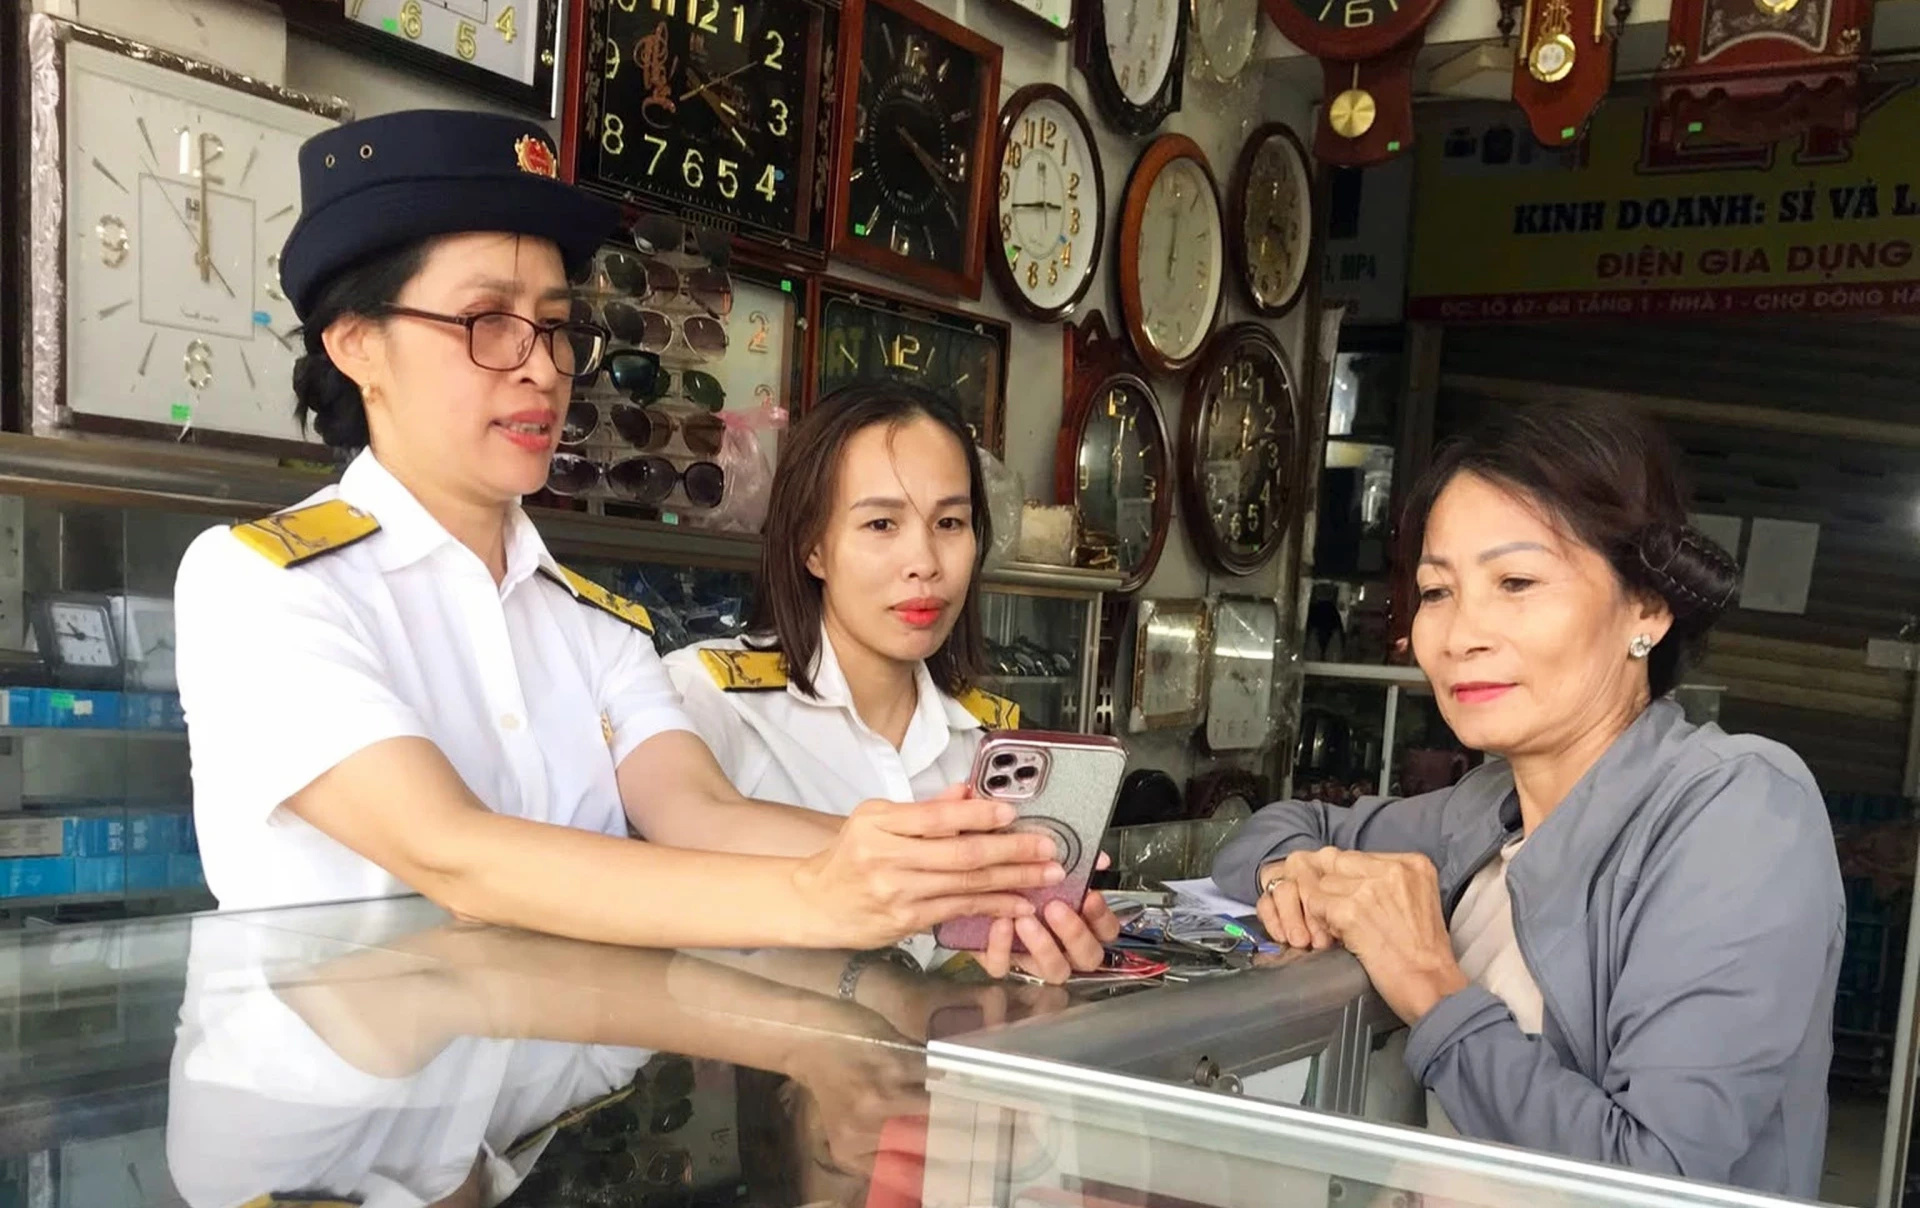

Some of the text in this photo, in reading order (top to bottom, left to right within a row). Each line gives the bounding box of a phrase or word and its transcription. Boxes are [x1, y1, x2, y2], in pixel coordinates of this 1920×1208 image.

[401, 1, 422, 40] 6
[494, 6, 517, 44] 4
[687, 0, 719, 34] 12
[733, 4, 744, 43] 1
[1344, 0, 1374, 28] 6
[457, 19, 477, 61] 5
[764, 30, 785, 71] 2
[602, 113, 624, 154] 8
[769, 99, 788, 137] 3
[1023, 117, 1035, 149] 11
[1040, 116, 1057, 148] 12
[644, 134, 667, 176] 7
[682, 149, 704, 188] 6
[1062, 138, 1068, 167] 1
[718, 159, 739, 198] 5
[755, 164, 776, 202] 4
[1068, 173, 1080, 199] 2
[1514, 201, 1606, 234] KINH
[1617, 195, 1766, 231] DOANH:
[1892, 184, 1920, 215] L
[96, 215, 130, 268] 9
[1597, 241, 1912, 284] ĐIỆN GIA DỤNG
[748, 311, 770, 354] 2
[183, 337, 213, 390] 6
[891, 334, 920, 371] 12
[1265, 405, 1276, 433] 2
[1268, 442, 1278, 470] 3
[1230, 512, 1242, 541] 6
[1248, 504, 1259, 532] 5
